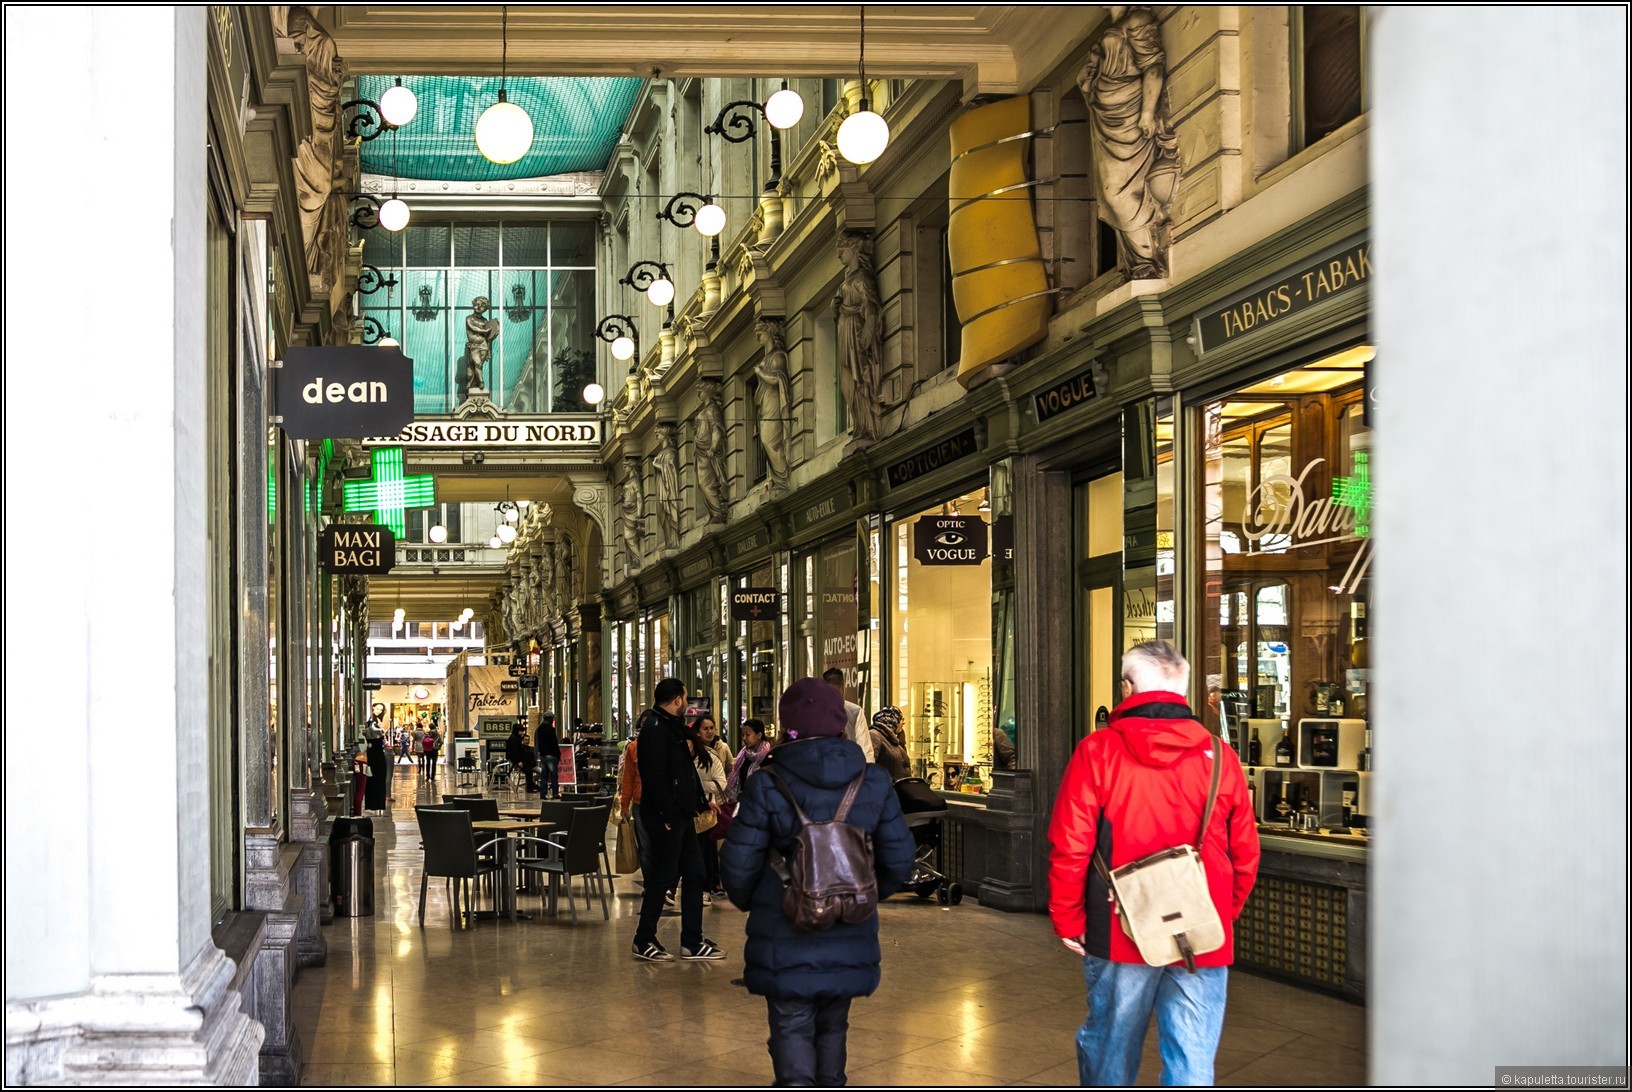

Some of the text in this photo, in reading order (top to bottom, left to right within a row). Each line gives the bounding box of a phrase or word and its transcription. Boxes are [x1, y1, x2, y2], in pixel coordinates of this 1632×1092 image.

[1221, 284, 1292, 338] TABACS
[302, 377, 388, 404] dean
[1039, 373, 1094, 416] VOGUE
[367, 425, 596, 442] SSAGE DU NORD
[898, 437, 963, 481] OPTICIEN
[936, 520, 966, 529] OPTIC
[334, 531, 380, 548] MAXI
[334, 550, 380, 567] BAGI
[926, 548, 977, 560] VOGUE
[734, 593, 776, 604] CONTACT
[469, 692, 512, 712] Fabiola
[485, 723, 511, 731] BASE
